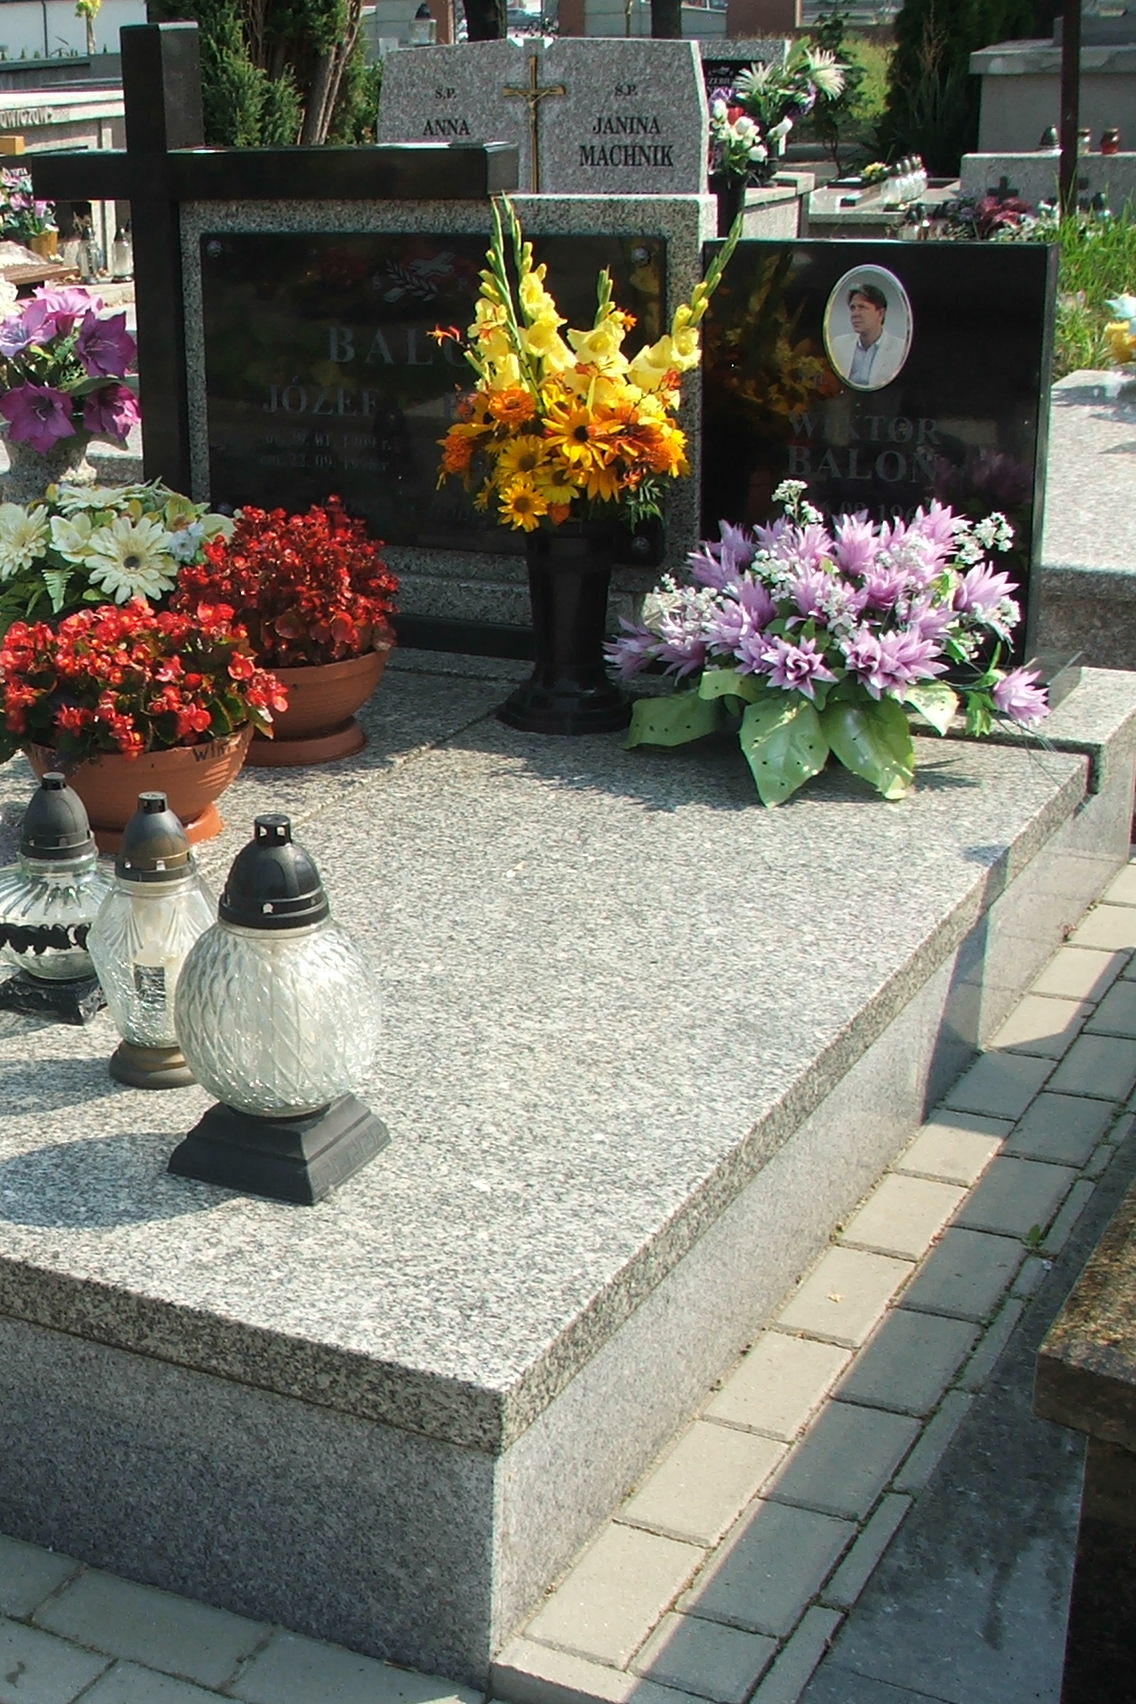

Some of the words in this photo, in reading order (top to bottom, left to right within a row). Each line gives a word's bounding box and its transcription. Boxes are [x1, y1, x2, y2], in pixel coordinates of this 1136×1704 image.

[422, 119, 471, 136] ANNA
[592, 116, 661, 135] JANINA
[579, 145, 674, 167] MACHNIK
[262, 375, 379, 417] JÓZEF
[789, 411, 941, 445] WIKTOR
